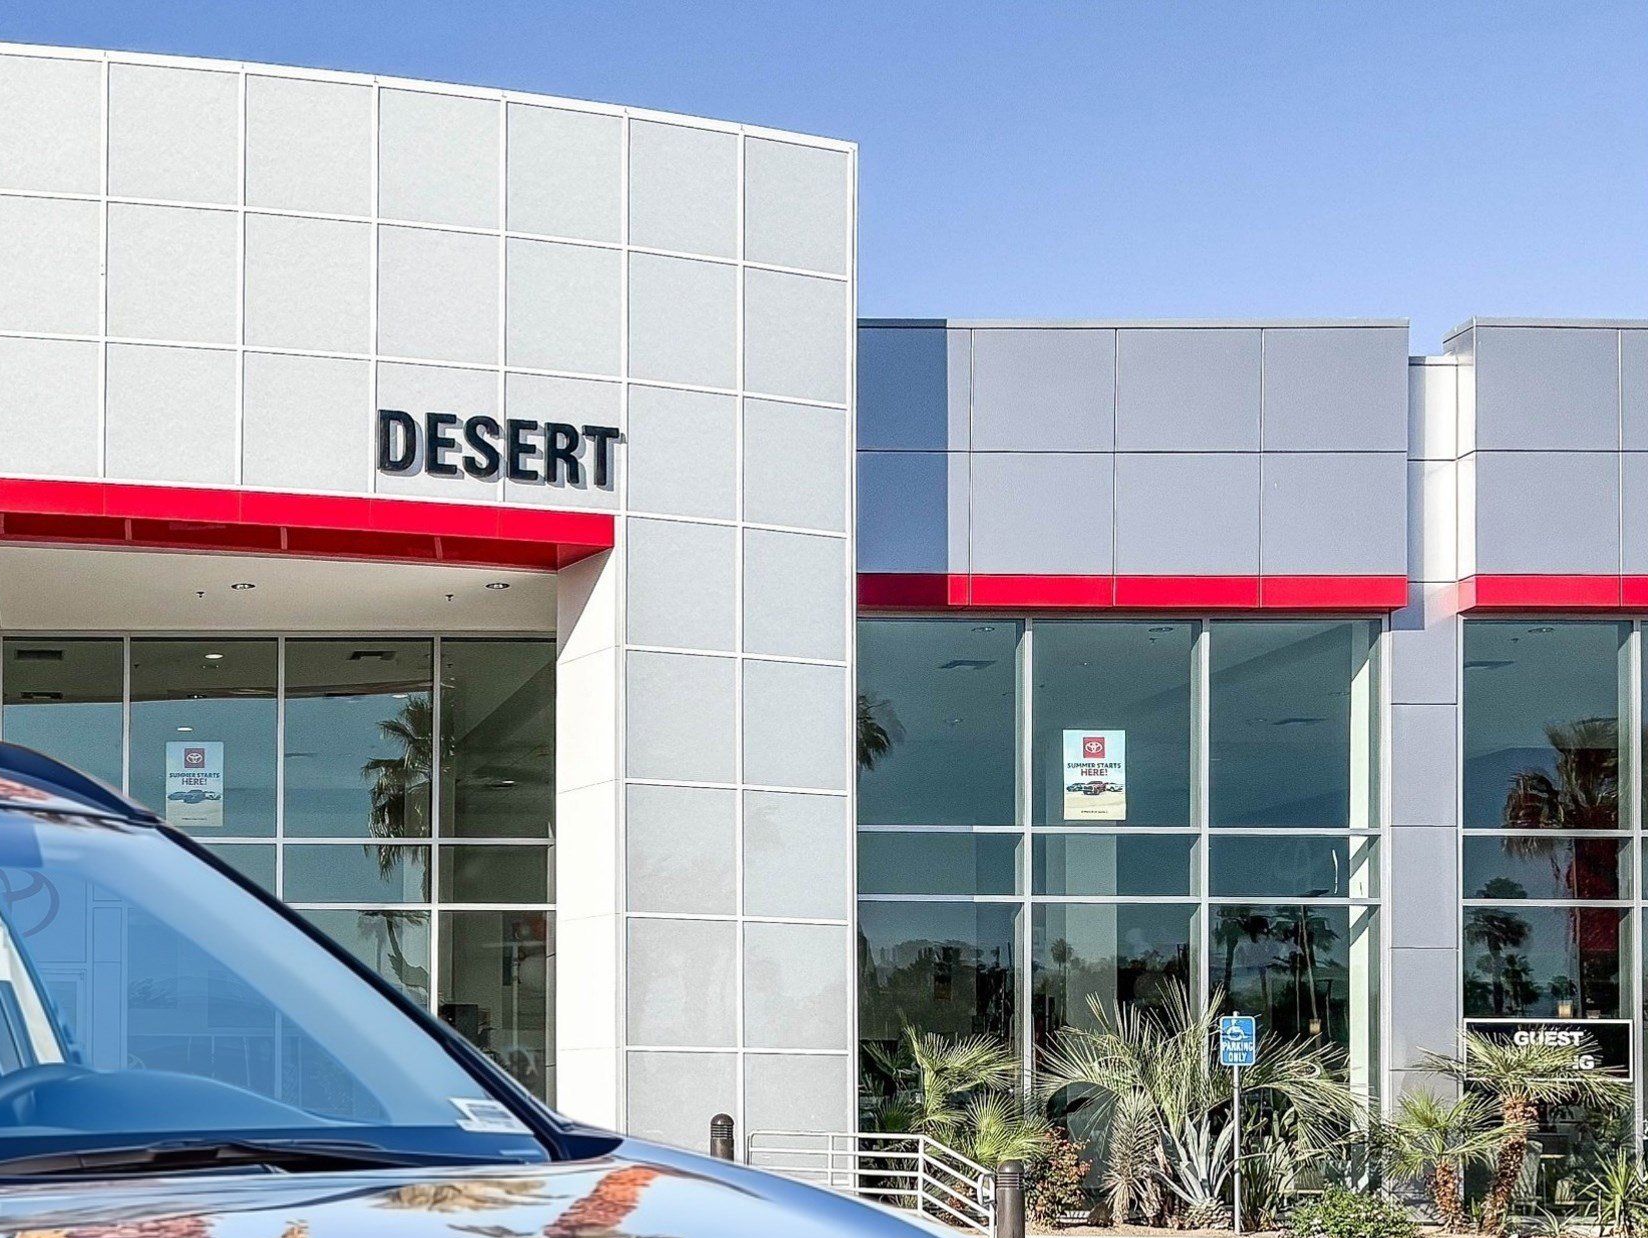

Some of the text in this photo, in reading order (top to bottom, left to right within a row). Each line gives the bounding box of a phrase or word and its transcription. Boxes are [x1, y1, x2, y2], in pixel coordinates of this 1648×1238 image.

[377, 409, 620, 487] DESERT
[1514, 1031, 1584, 1046] GUEST
[1222, 1042, 1253, 1052] PARKING
[1228, 1052, 1247, 1061] ONLY
